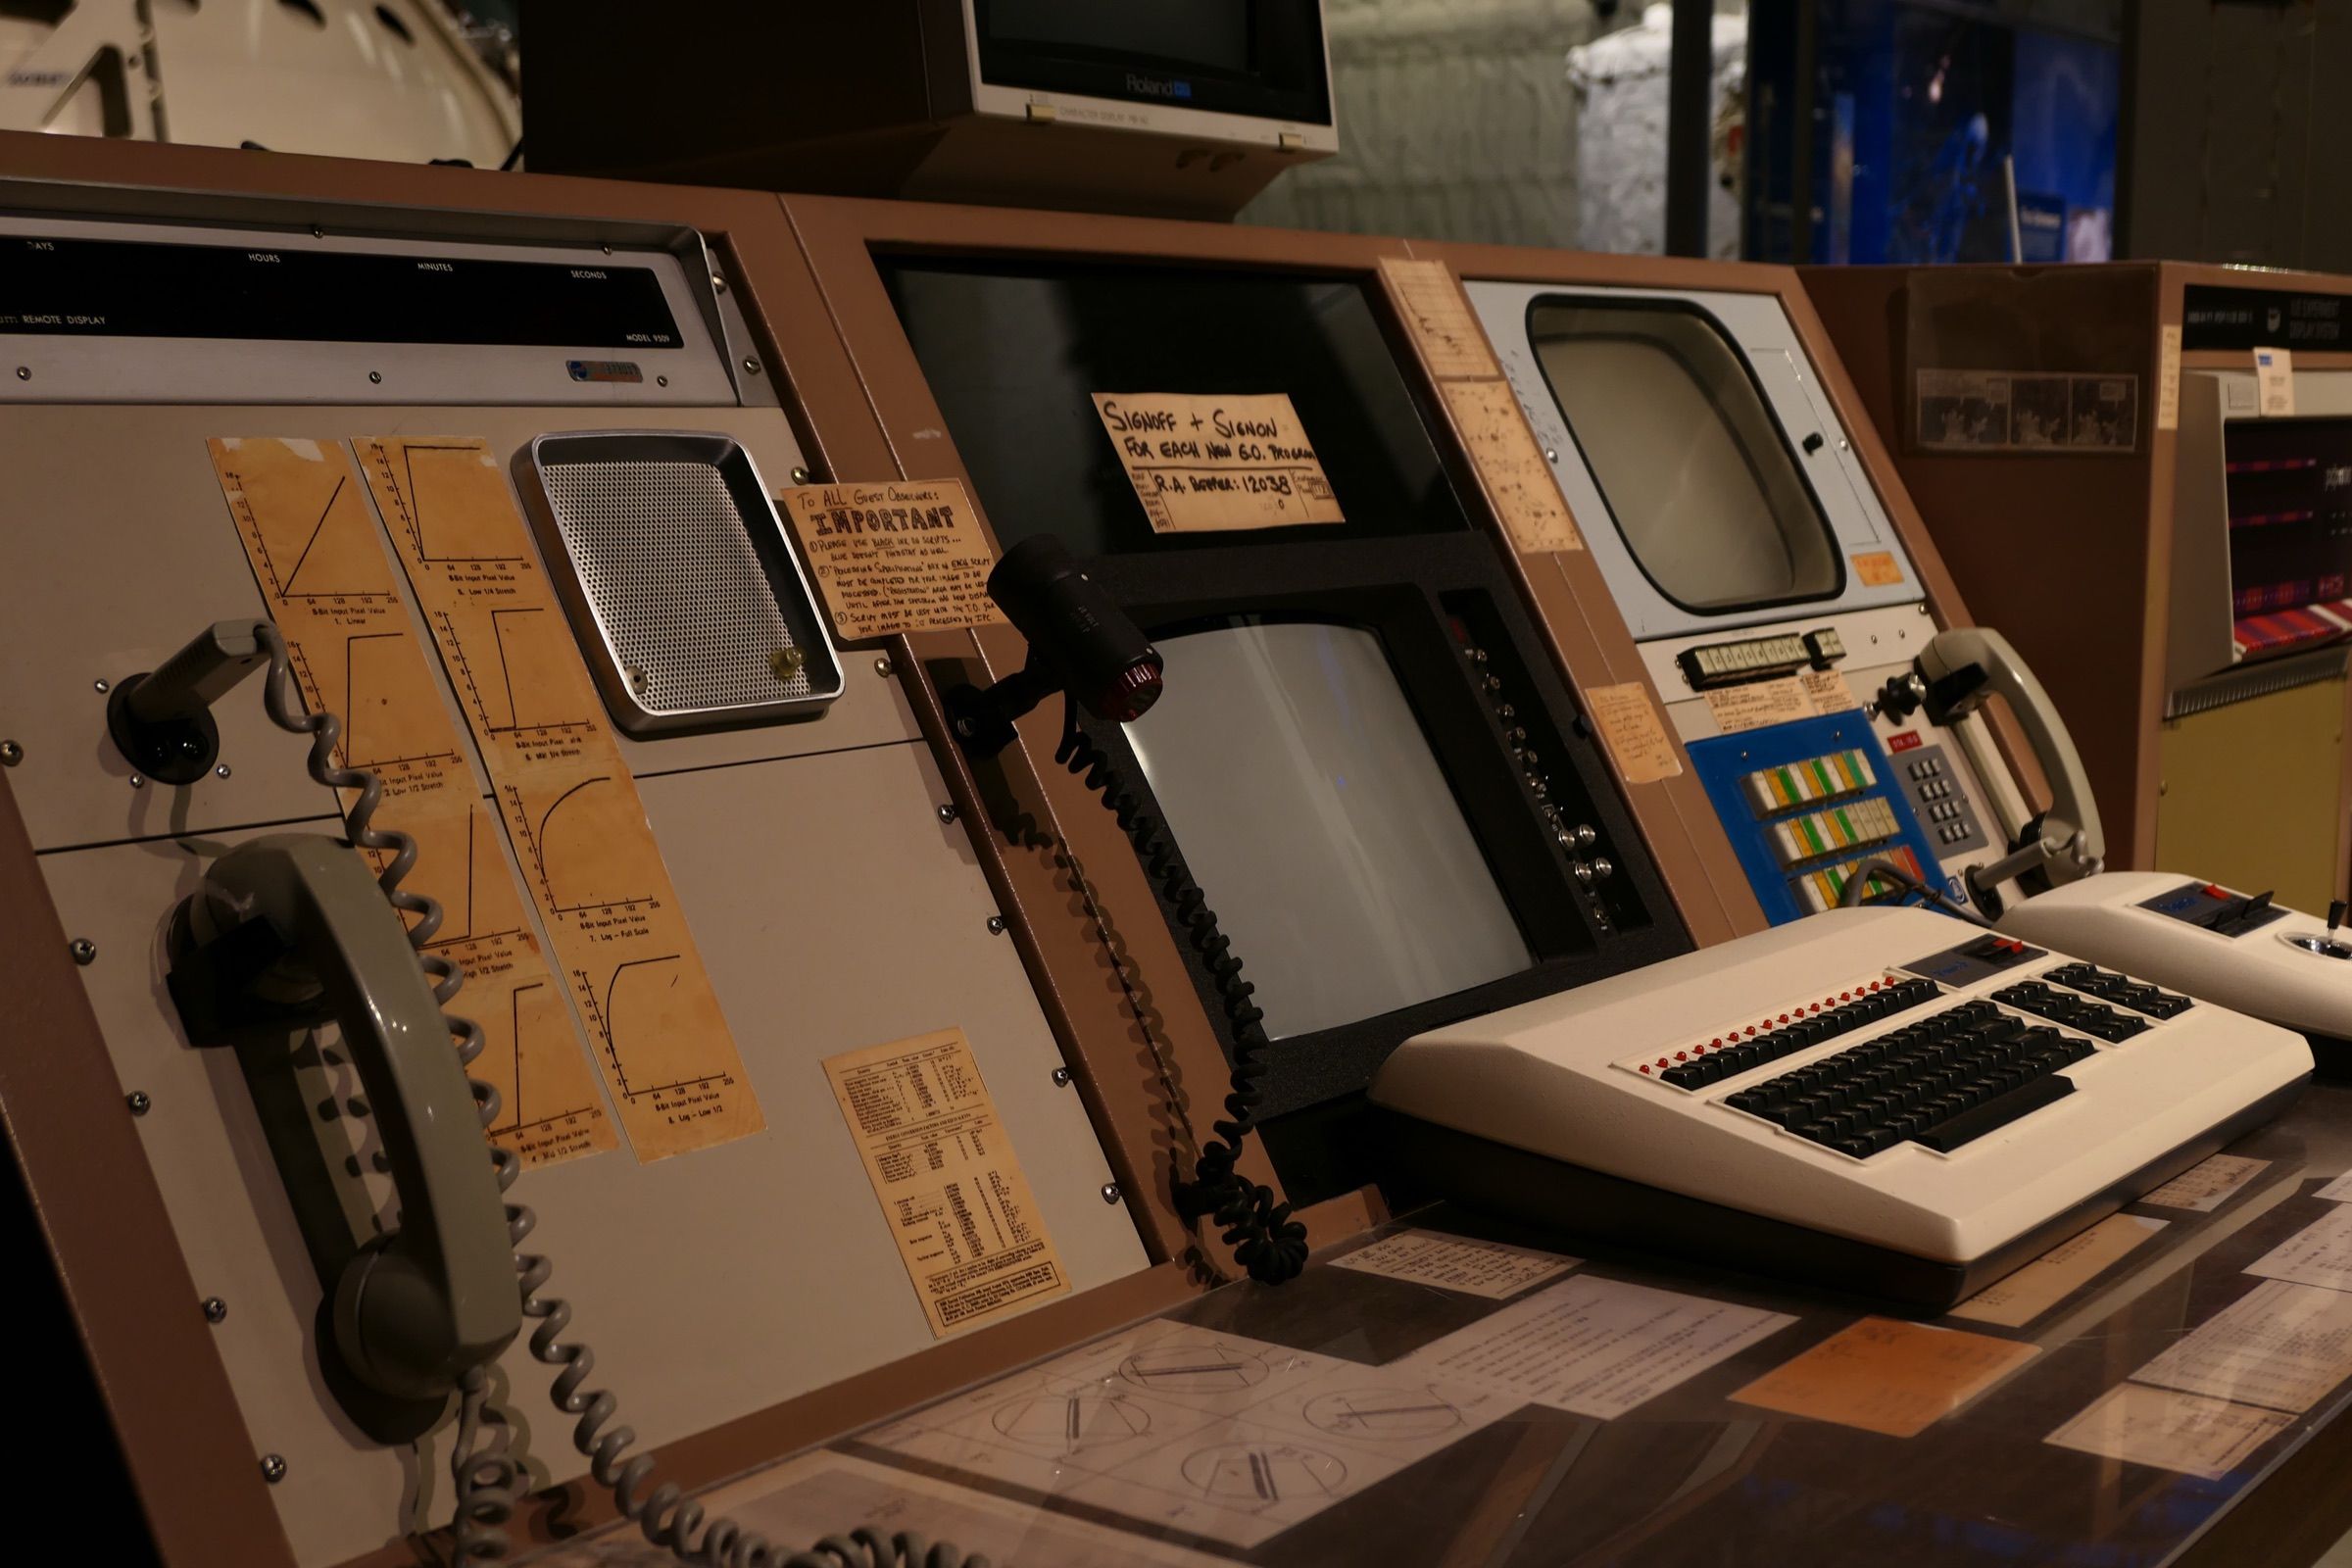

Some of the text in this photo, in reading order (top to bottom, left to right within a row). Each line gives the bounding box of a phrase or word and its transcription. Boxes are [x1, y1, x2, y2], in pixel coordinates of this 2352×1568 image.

[1126, 74, 1172, 96] Roland
[248, 253, 281, 264] HOURS
[416, 263, 454, 272] MINUTES
[569, 270, 608, 280] SECONDS
[22, 315, 63, 324] REMOTE
[66, 315, 106, 325] DISPLAY
[625, 333, 651, 342] MODEL
[1103, 401, 1278, 439] SIGNOFF + SIGNON
[1123, 435, 1154, 460] FOR
[1159, 441, 1200, 460] EACH
[1206, 442, 1232, 460] NEW
[1153, 474, 1186, 495] R.A.
[1242, 474, 1293, 496] 12038
[823, 487, 848, 508] ALL
[854, 489, 883, 506] GUEST
[809, 505, 955, 536] IMPORTANT
[819, 539, 848, 552] PLEASE
[873, 538, 896, 547] BLACK
[951, 560, 969, 568] EACH
[331, 608, 349, 616] Input
[845, 601, 868, 611] UNTIL
[532, 739, 549, 748] Input
[389, 776, 407, 786] Input
[408, 774, 423, 783] Pixel
[424, 771, 444, 781] Value
[392, 787, 407, 796] Low
[420, 782, 444, 791] Stretch
[596, 920, 612, 929] Input
[600, 933, 613, 942] Log
[620, 930, 632, 939] Full
[459, 956, 476, 966] Input
[495, 949, 513, 957] Value
[670, 1101, 687, 1109] Input
[687, 1096, 703, 1104] Pixel
[705, 1092, 720, 1102] Value
[678, 1113, 691, 1123] Log
[698, 1108, 711, 1117] Low
[712, 1105, 723, 1114] 1/2
